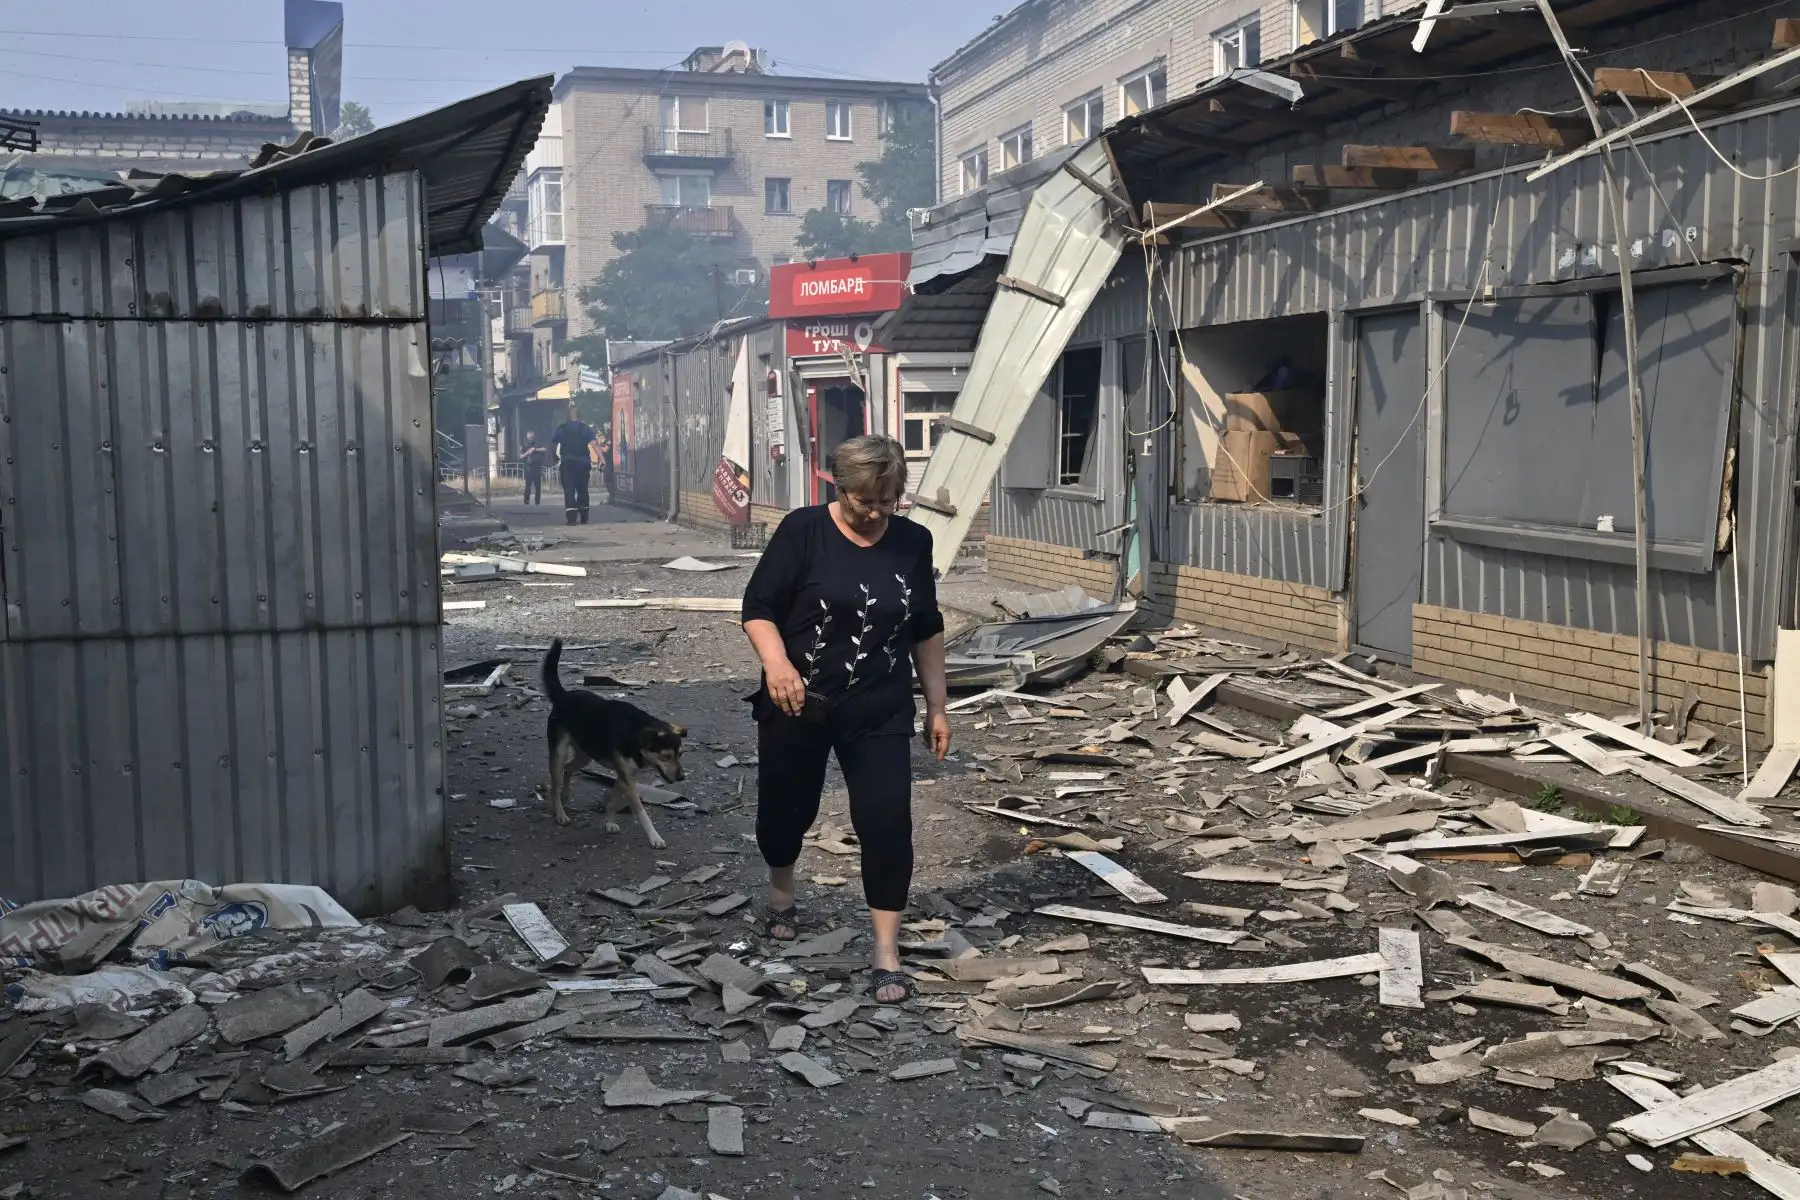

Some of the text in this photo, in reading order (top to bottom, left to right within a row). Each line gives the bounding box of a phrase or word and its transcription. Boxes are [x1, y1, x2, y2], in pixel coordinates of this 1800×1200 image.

[800, 277, 864, 297] ЛОМБАРД
[804, 323, 849, 339] ГРОШІ
[812, 339, 841, 353] ТУТ
